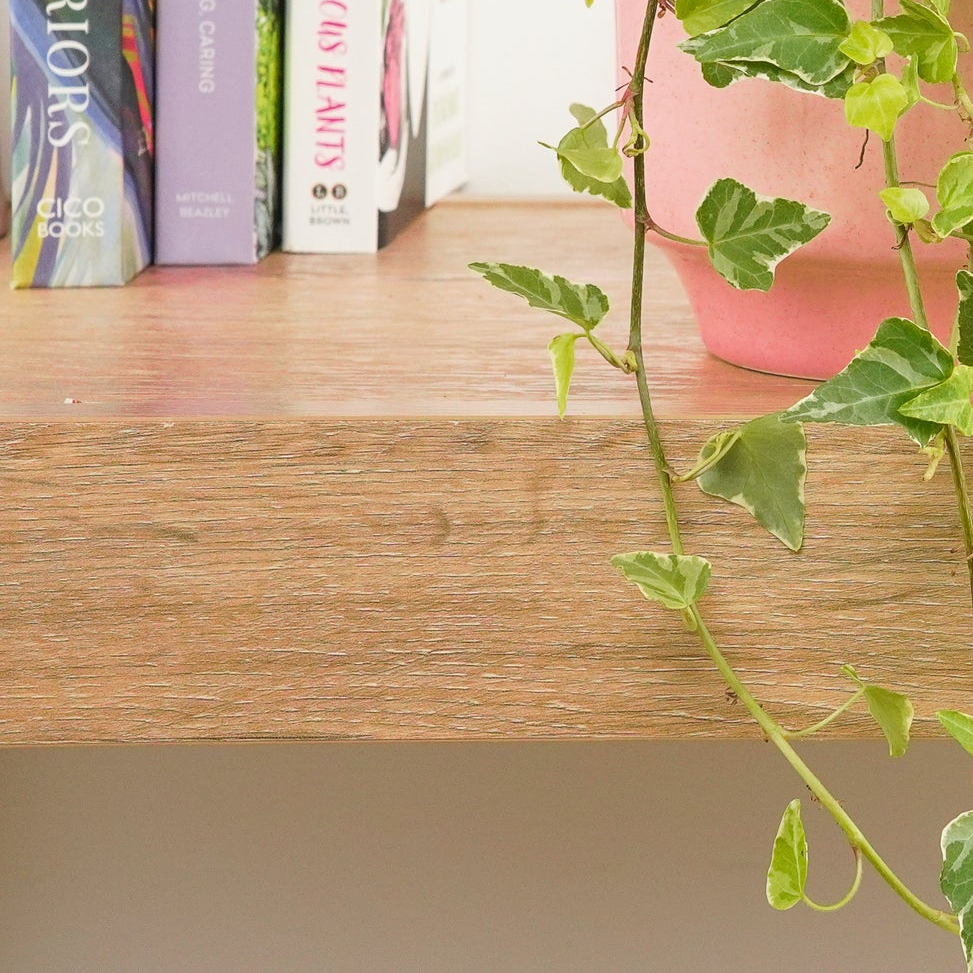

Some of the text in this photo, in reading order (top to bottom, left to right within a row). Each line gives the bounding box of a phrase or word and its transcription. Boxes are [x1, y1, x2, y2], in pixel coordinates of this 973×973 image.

[198, 21, 216, 94] CARING
[314, 64, 346, 170] PLANTS
[175, 192, 234, 204] MITCHELL
[36, 197, 105, 219] CICO
[179, 207, 230, 218] BEAZLEY
[37, 221, 105, 238] BOOKS
